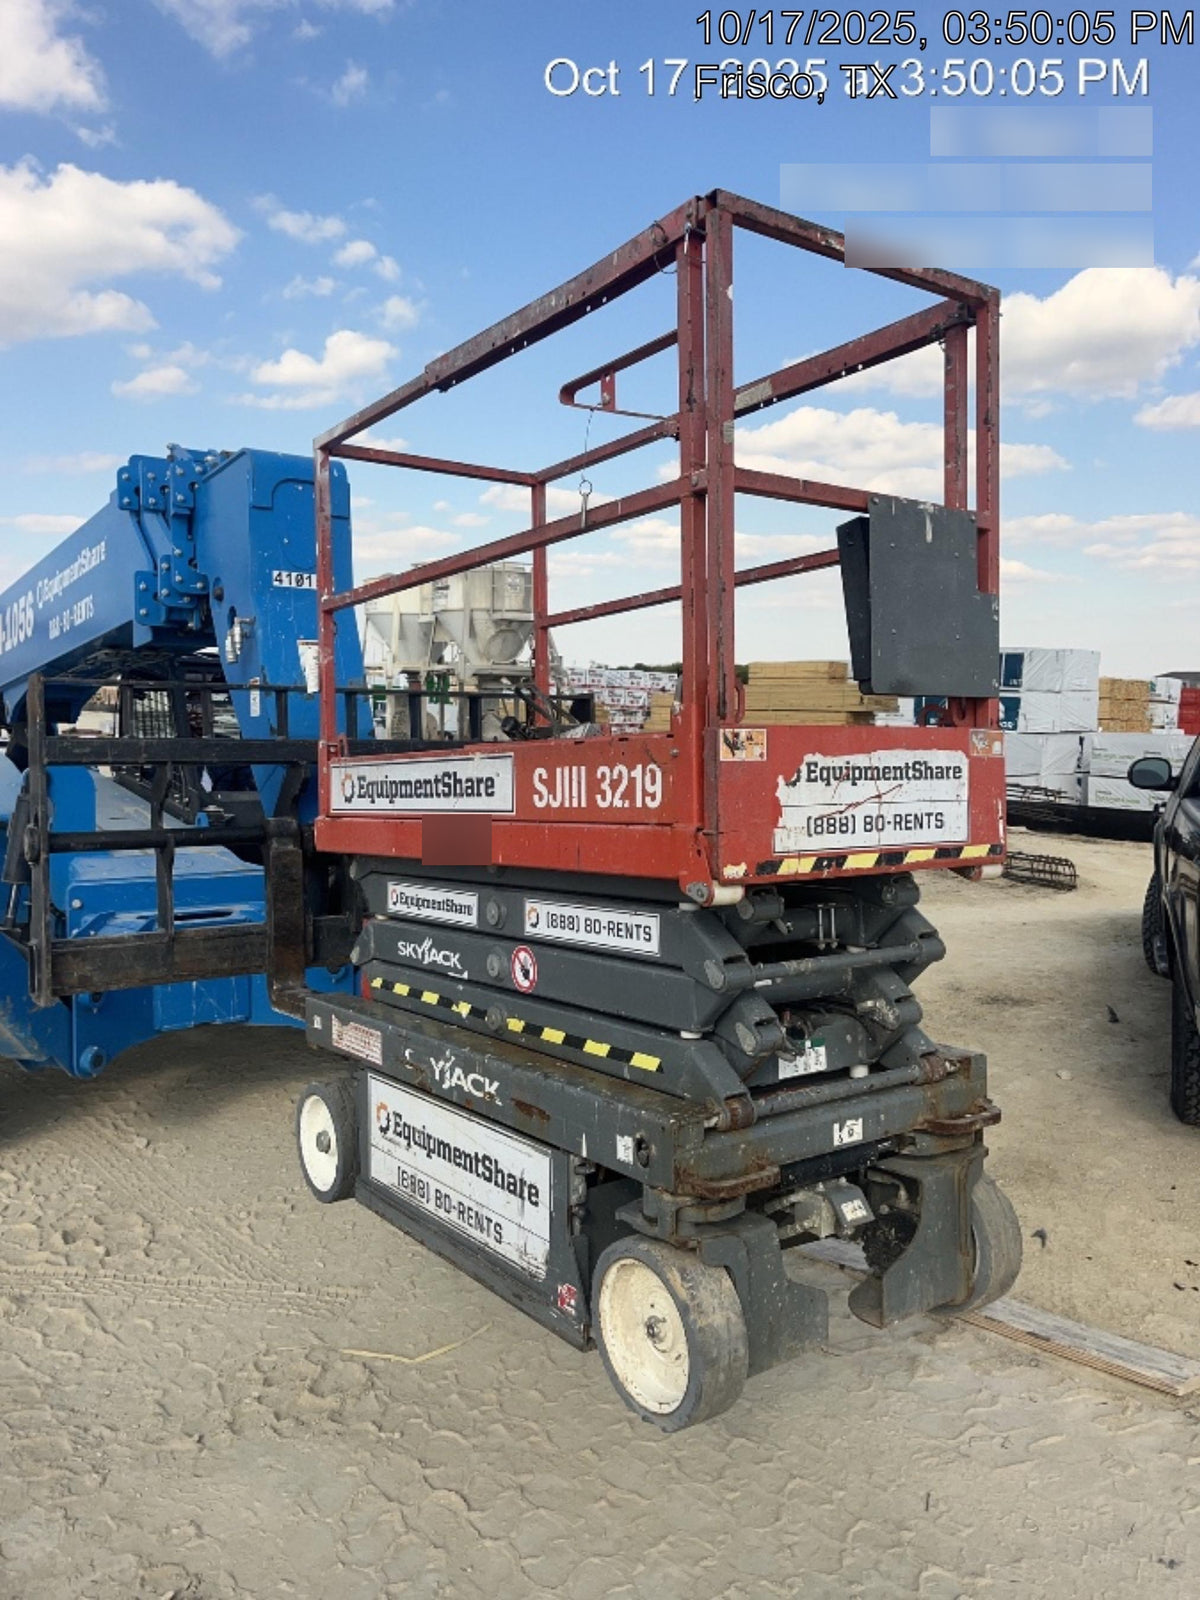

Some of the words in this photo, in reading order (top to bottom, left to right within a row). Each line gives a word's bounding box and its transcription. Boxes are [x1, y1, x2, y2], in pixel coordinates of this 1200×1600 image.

[0, 590, 34, 655] -1056
[356, 770, 496, 800] EquipmentShare
[596, 763, 663, 808] 3219
[805, 761, 963, 783] EquipmentShare
[399, 891, 473, 917] EquipmentShare
[397, 937, 463, 970] SKYJACK
[392, 1110, 540, 1207] EquipmentShare
